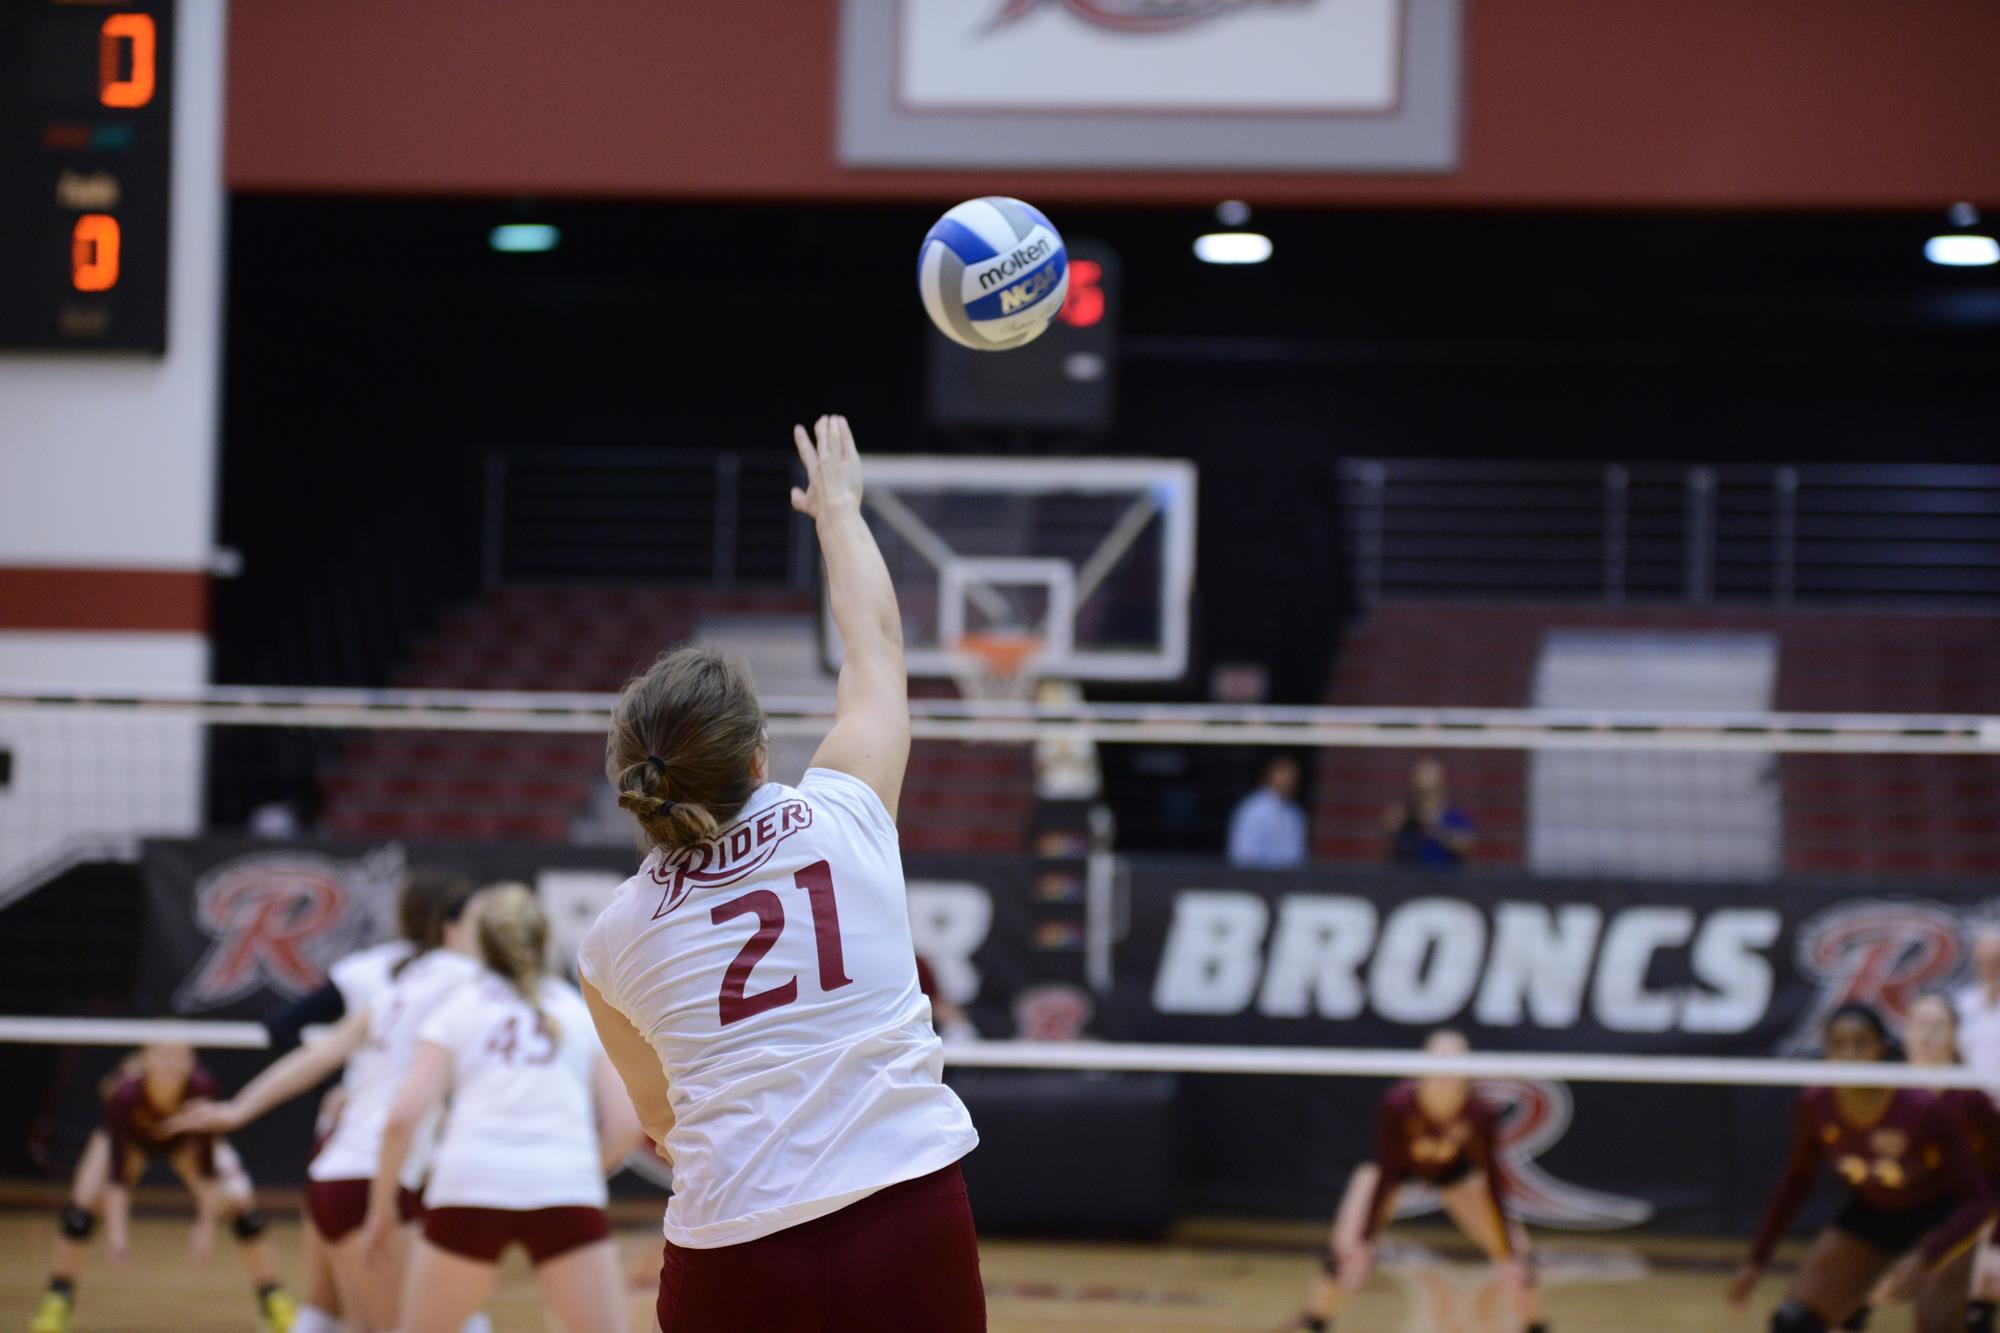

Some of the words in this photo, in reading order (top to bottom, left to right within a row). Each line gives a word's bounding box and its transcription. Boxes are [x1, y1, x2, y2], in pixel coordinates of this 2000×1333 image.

[979, 237, 1051, 290] molten
[651, 800, 811, 910] RIDER
[710, 859, 853, 1027] 21
[1152, 888, 1781, 1034] BRONCS
